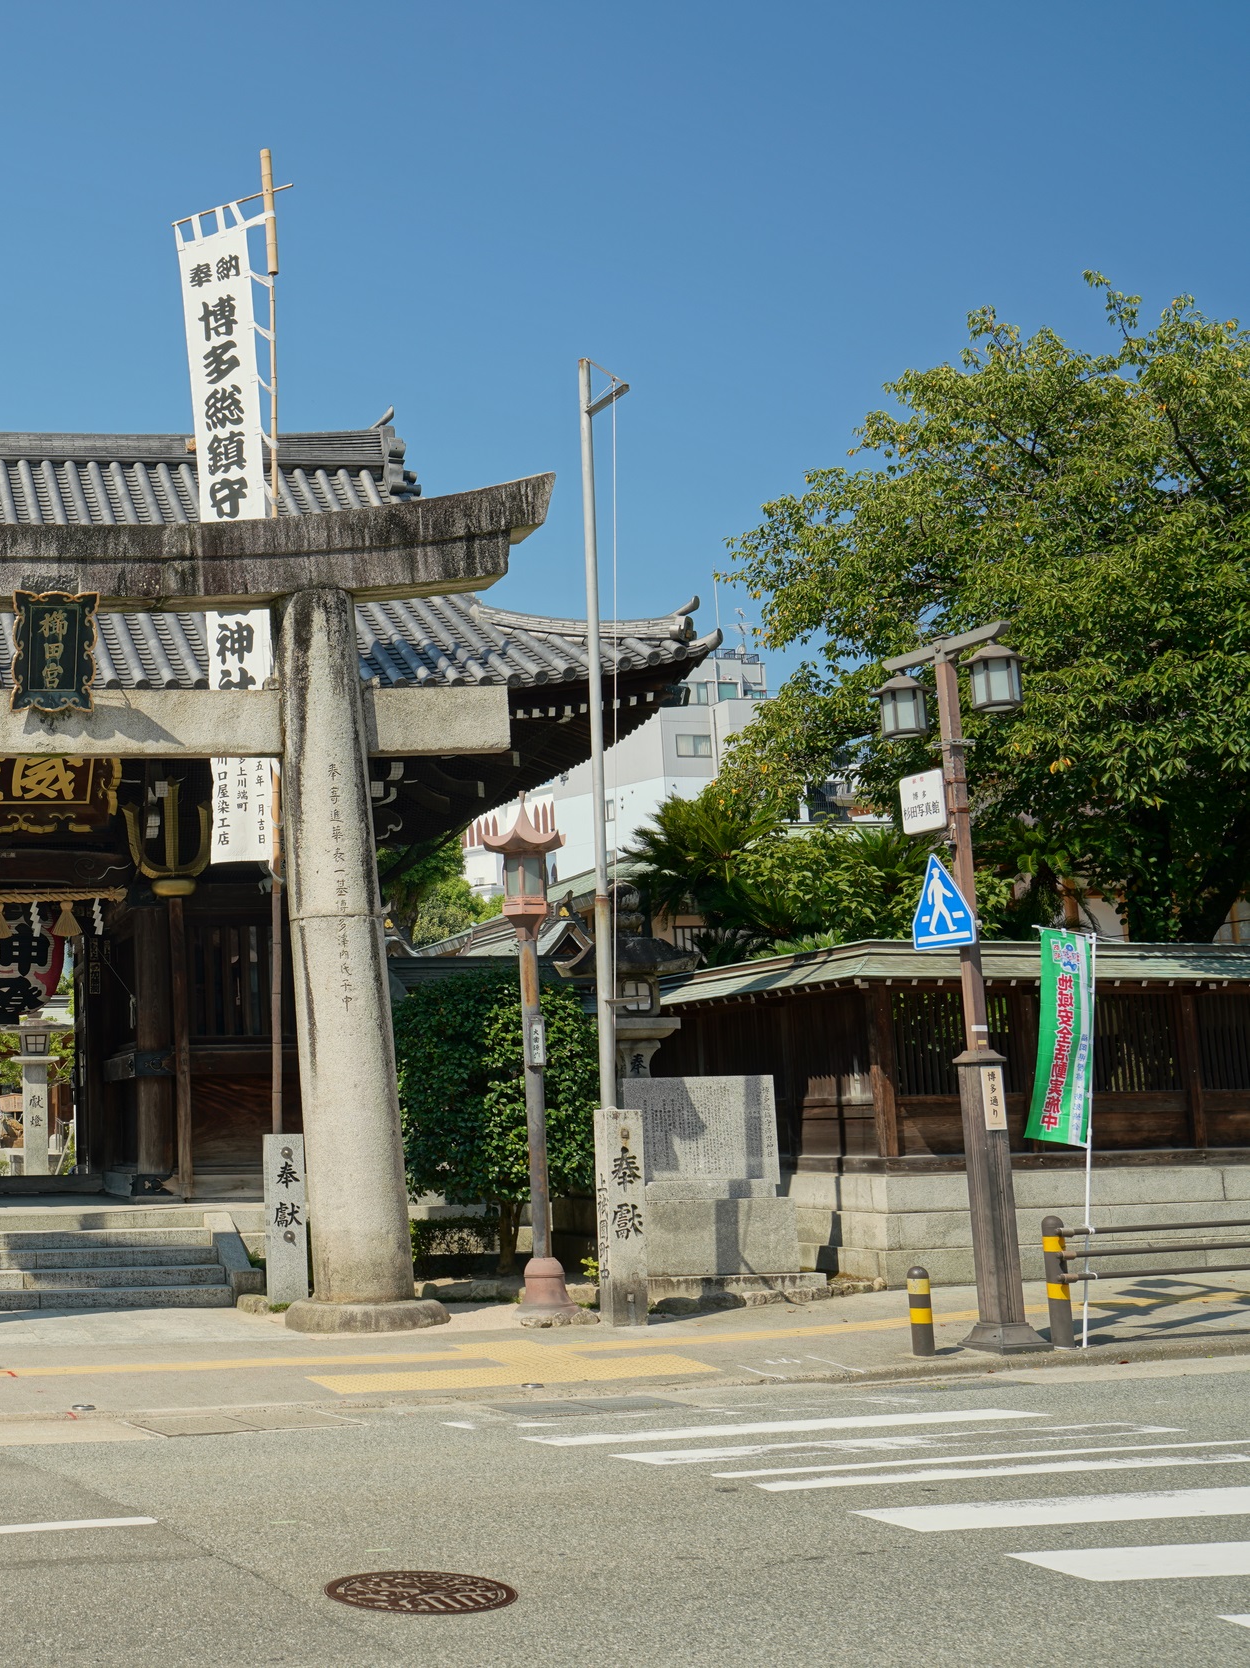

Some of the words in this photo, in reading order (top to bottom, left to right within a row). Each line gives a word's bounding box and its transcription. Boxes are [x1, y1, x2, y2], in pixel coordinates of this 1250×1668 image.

[189, 254, 241, 288] 奉納
[198, 294, 248, 519] 博多総鎮守
[38, 609, 69, 689] 櫛田宮
[216, 611, 256, 690] 神社
[255, 760, 266, 844] 五年一月吉日
[903, 800, 940, 820] 杉田写真館
[912, 790, 927, 801] 博多
[987, 1070, 1000, 1118] 博多通り
